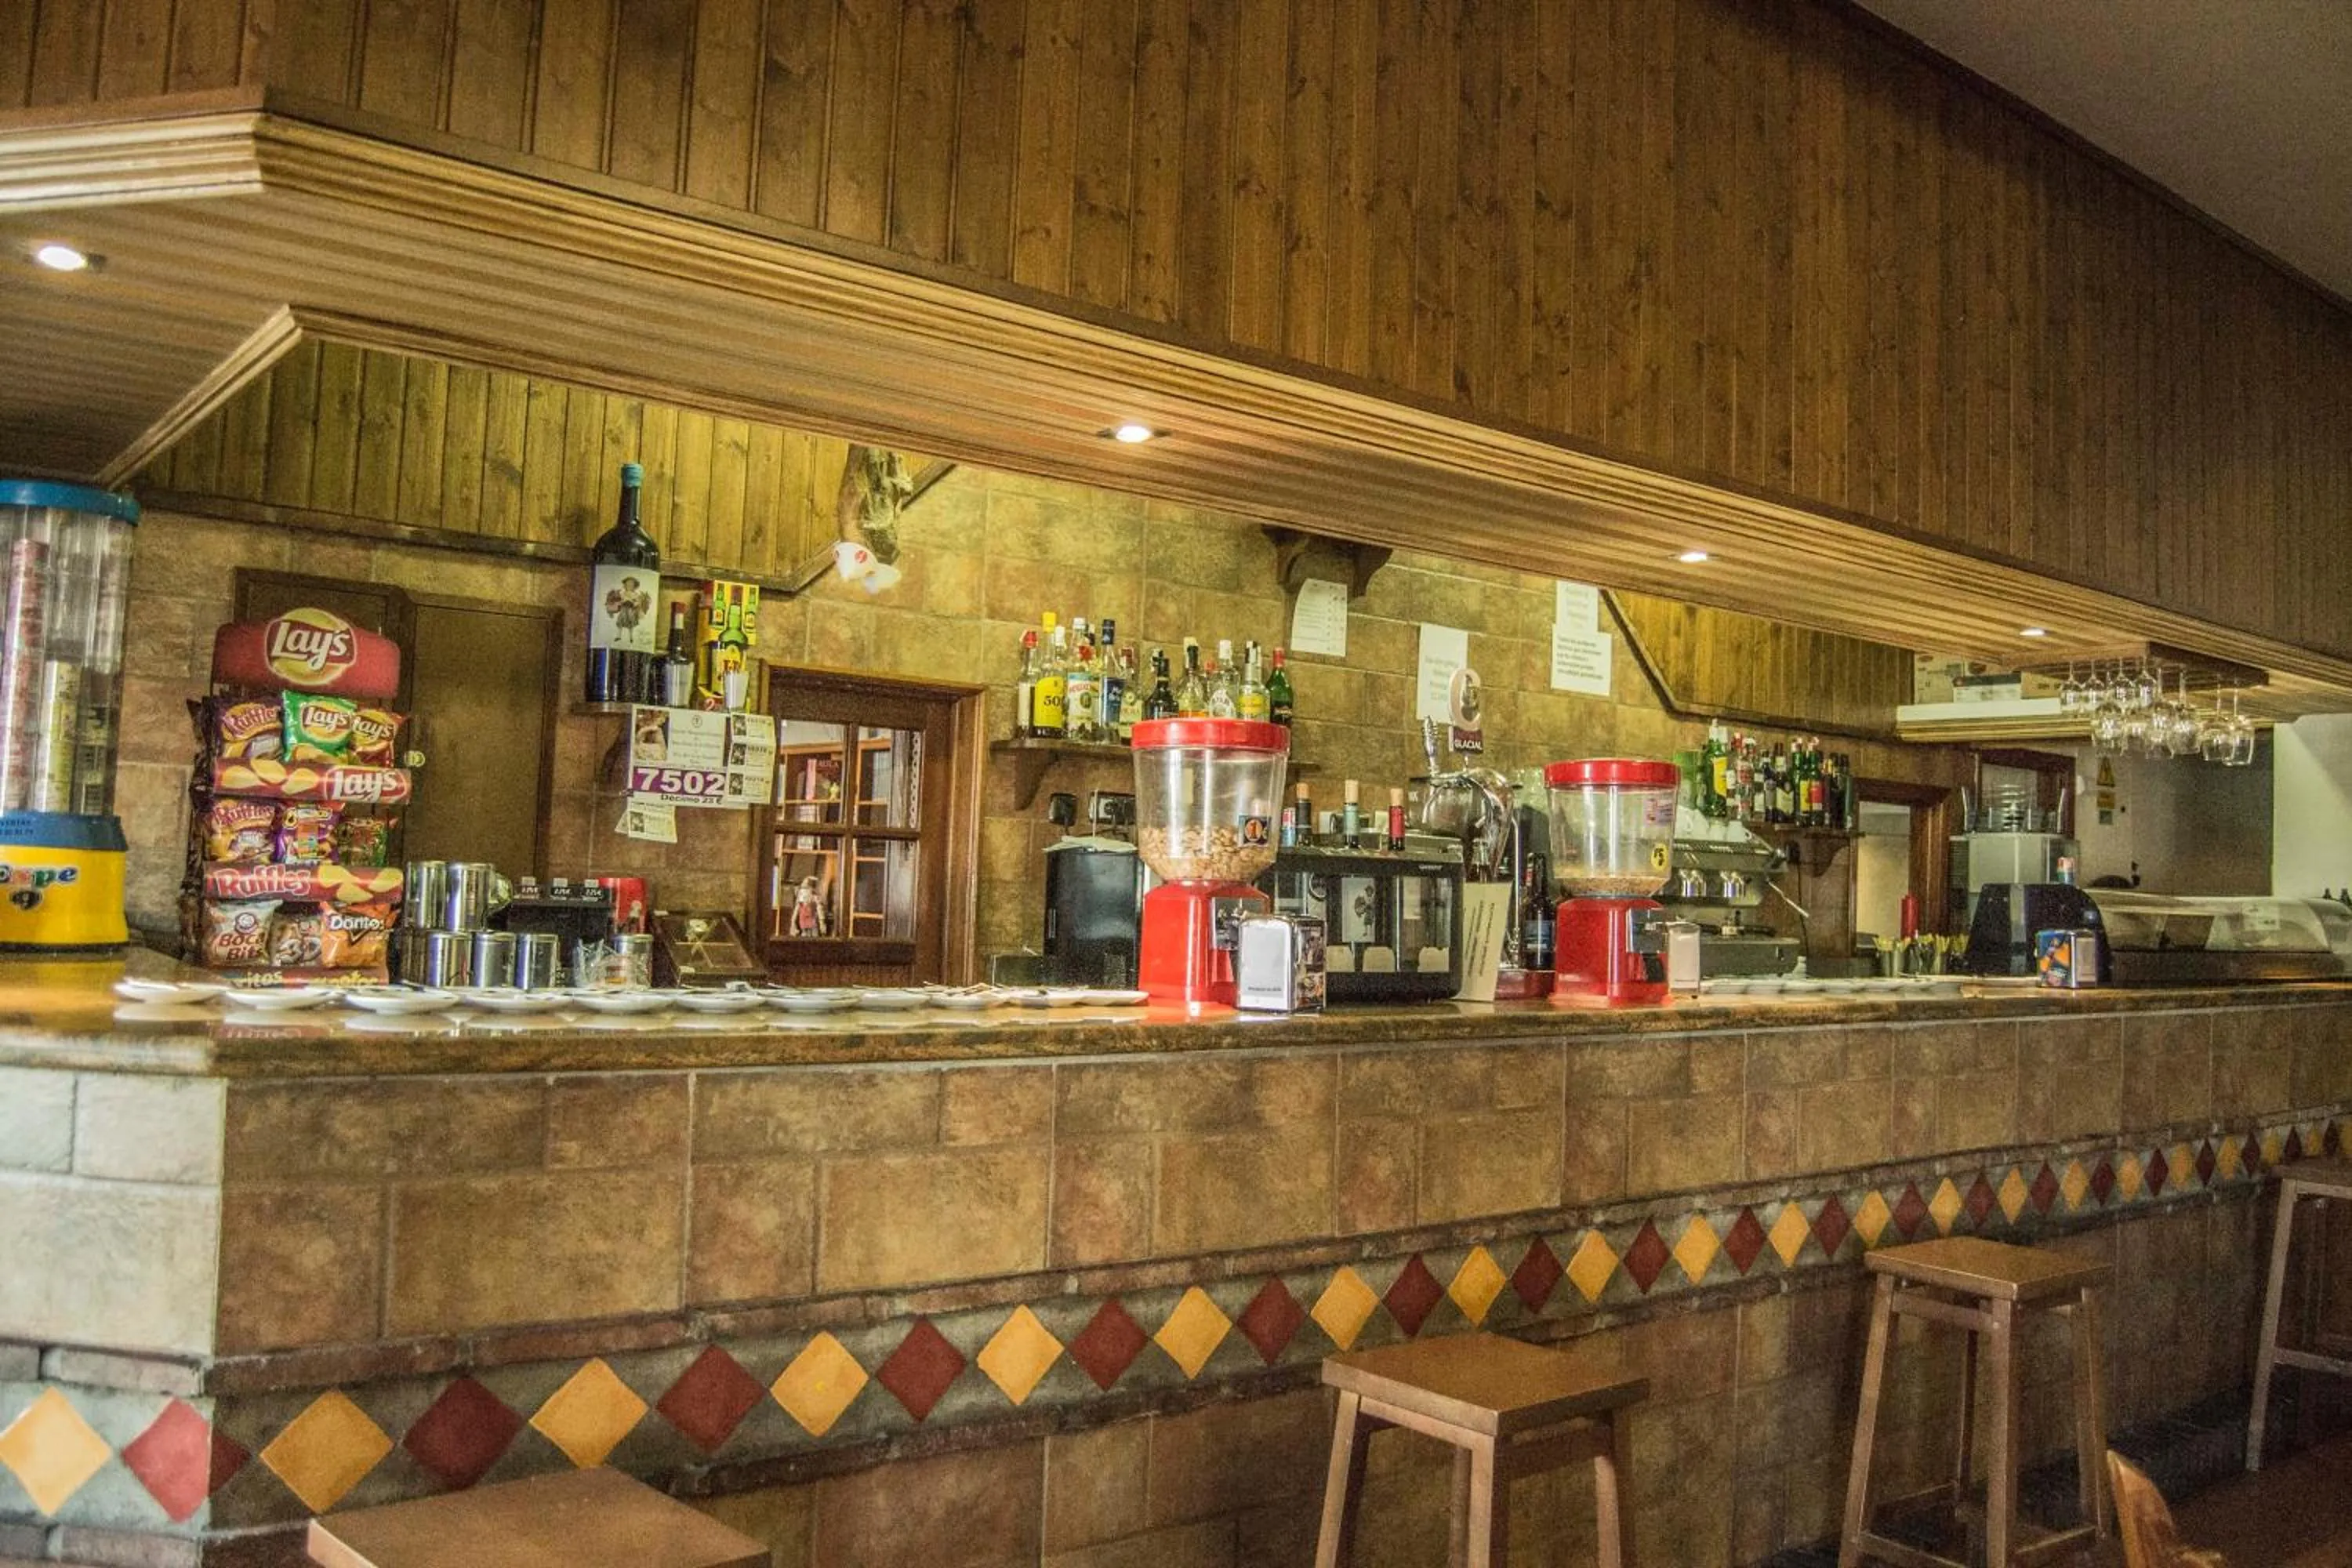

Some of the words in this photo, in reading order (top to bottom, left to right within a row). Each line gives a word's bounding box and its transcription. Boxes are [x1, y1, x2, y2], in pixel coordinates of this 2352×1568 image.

[271, 622, 350, 672] Lay's
[303, 706, 353, 730] Lay's
[331, 768, 397, 802] Lay's
[214, 863, 310, 898] Ruffles
